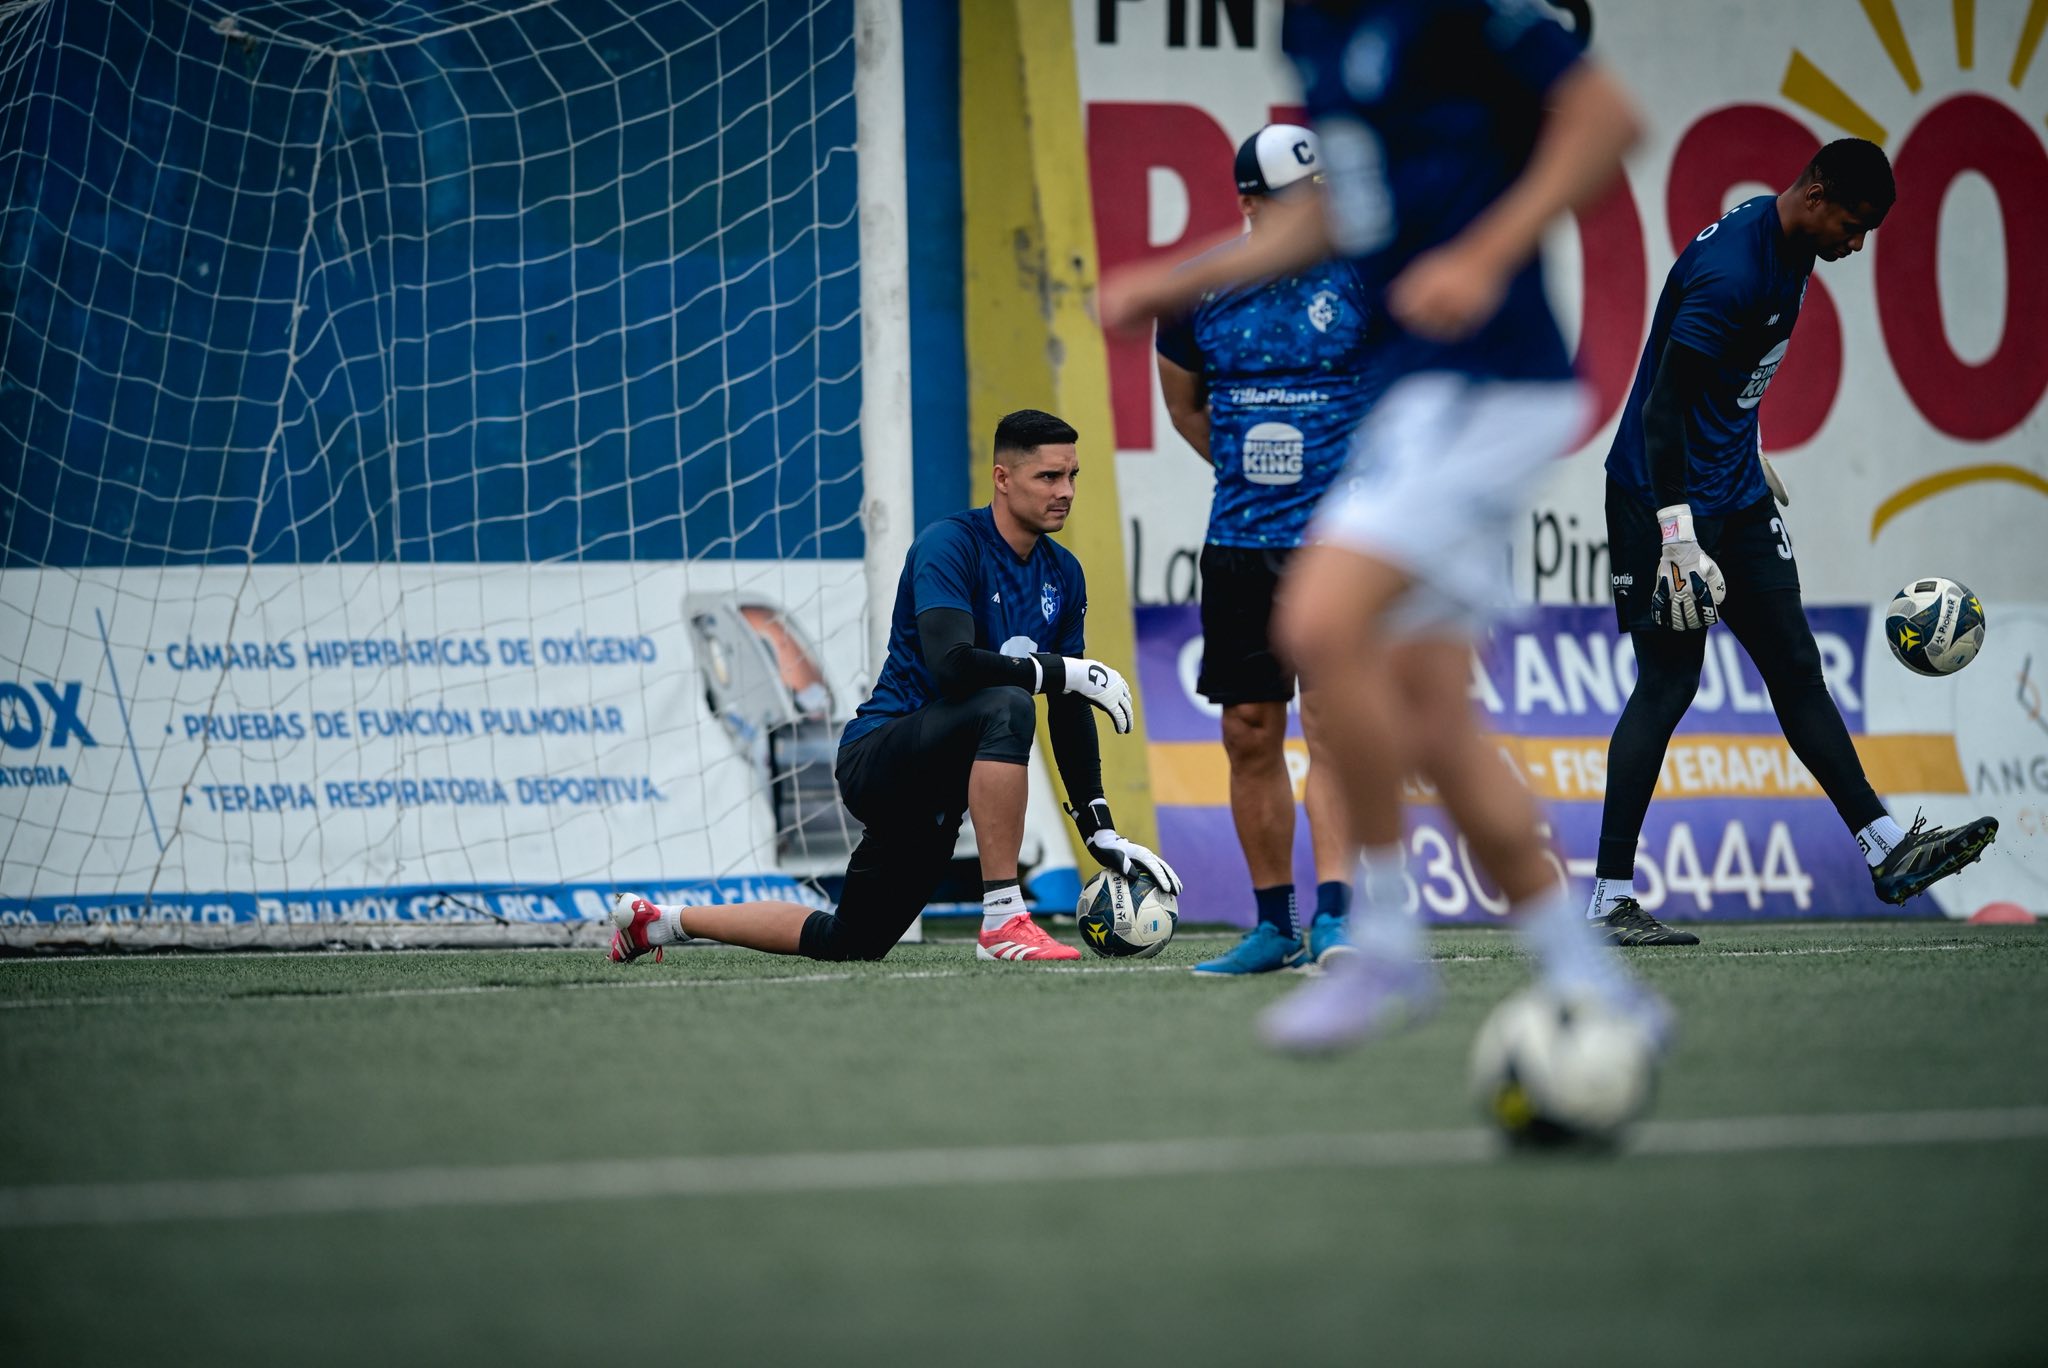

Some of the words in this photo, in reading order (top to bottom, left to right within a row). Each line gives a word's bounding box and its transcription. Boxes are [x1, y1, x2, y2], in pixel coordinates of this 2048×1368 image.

[1292, 140, 1315, 165] C
[1243, 440, 1304, 455] BURGER
[1242, 455, 1304, 474] KING
[166, 633, 296, 670] CÁMARAS
[304, 630, 491, 667] HIPERBÁRICAS
[498, 639, 534, 666] DE
[541, 629, 657, 666] OXÍGENO
[183, 712, 306, 741] PRUEBAS
[313, 711, 352, 739] DE
[358, 697, 474, 737] FUNCIÓN
[480, 705, 625, 737] PULMONAR
[201, 783, 318, 812] TERAPIA
[325, 776, 509, 809] RESPIRATORIA
